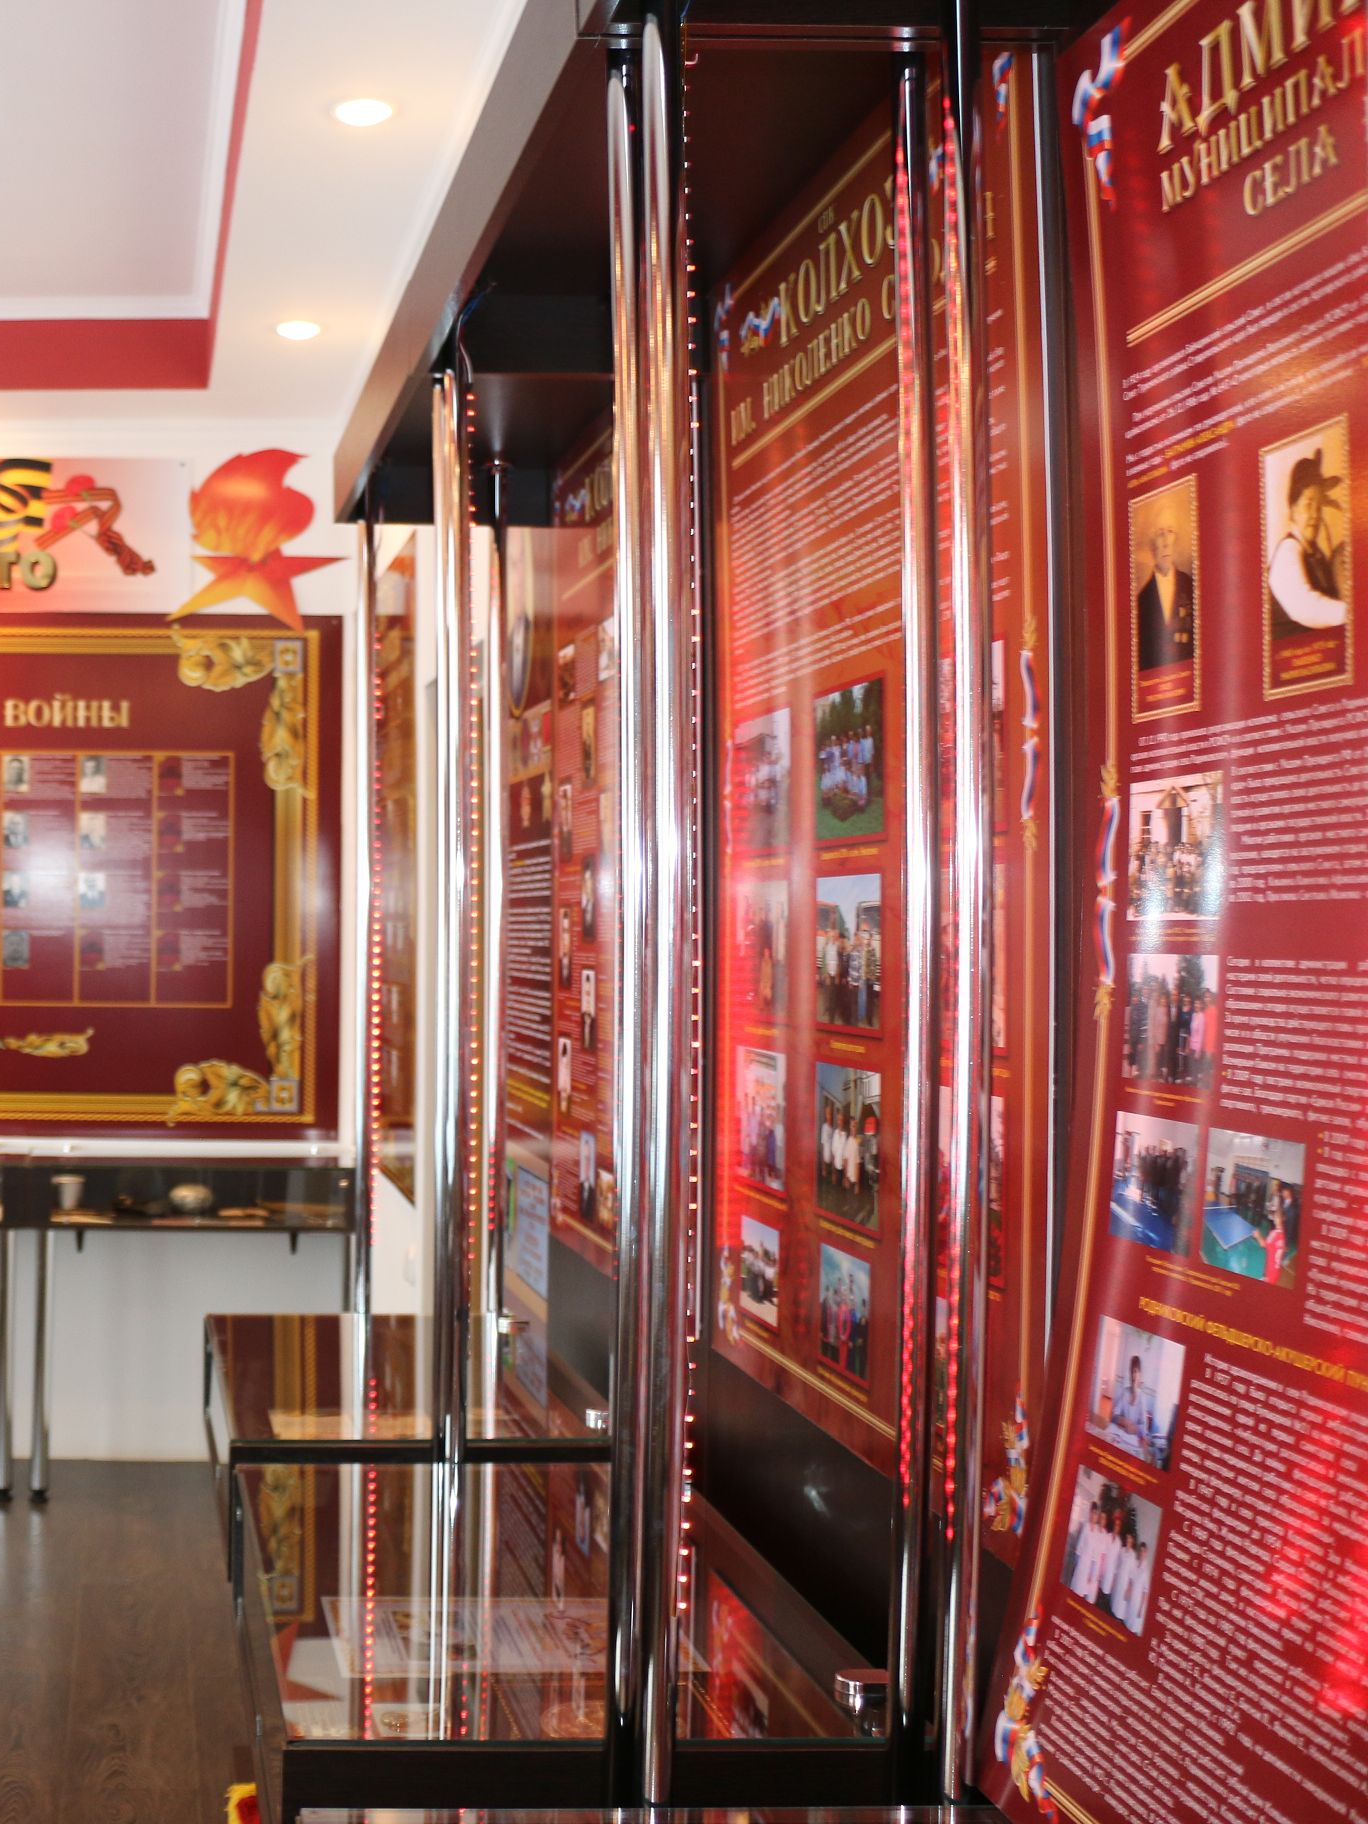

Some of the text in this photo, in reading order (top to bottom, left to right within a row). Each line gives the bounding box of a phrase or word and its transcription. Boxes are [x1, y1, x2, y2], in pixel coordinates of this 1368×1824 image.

[1157, 0, 1362, 155] АДМ
[1160, 27, 1367, 213] МУНИЦИПАЛ
[1243, 124, 1338, 216] СЕЛА
[731, 298, 871, 446] ИМ. НИКОЛЕНКО
[3, 691, 131, 728] ВОЙНЫ
